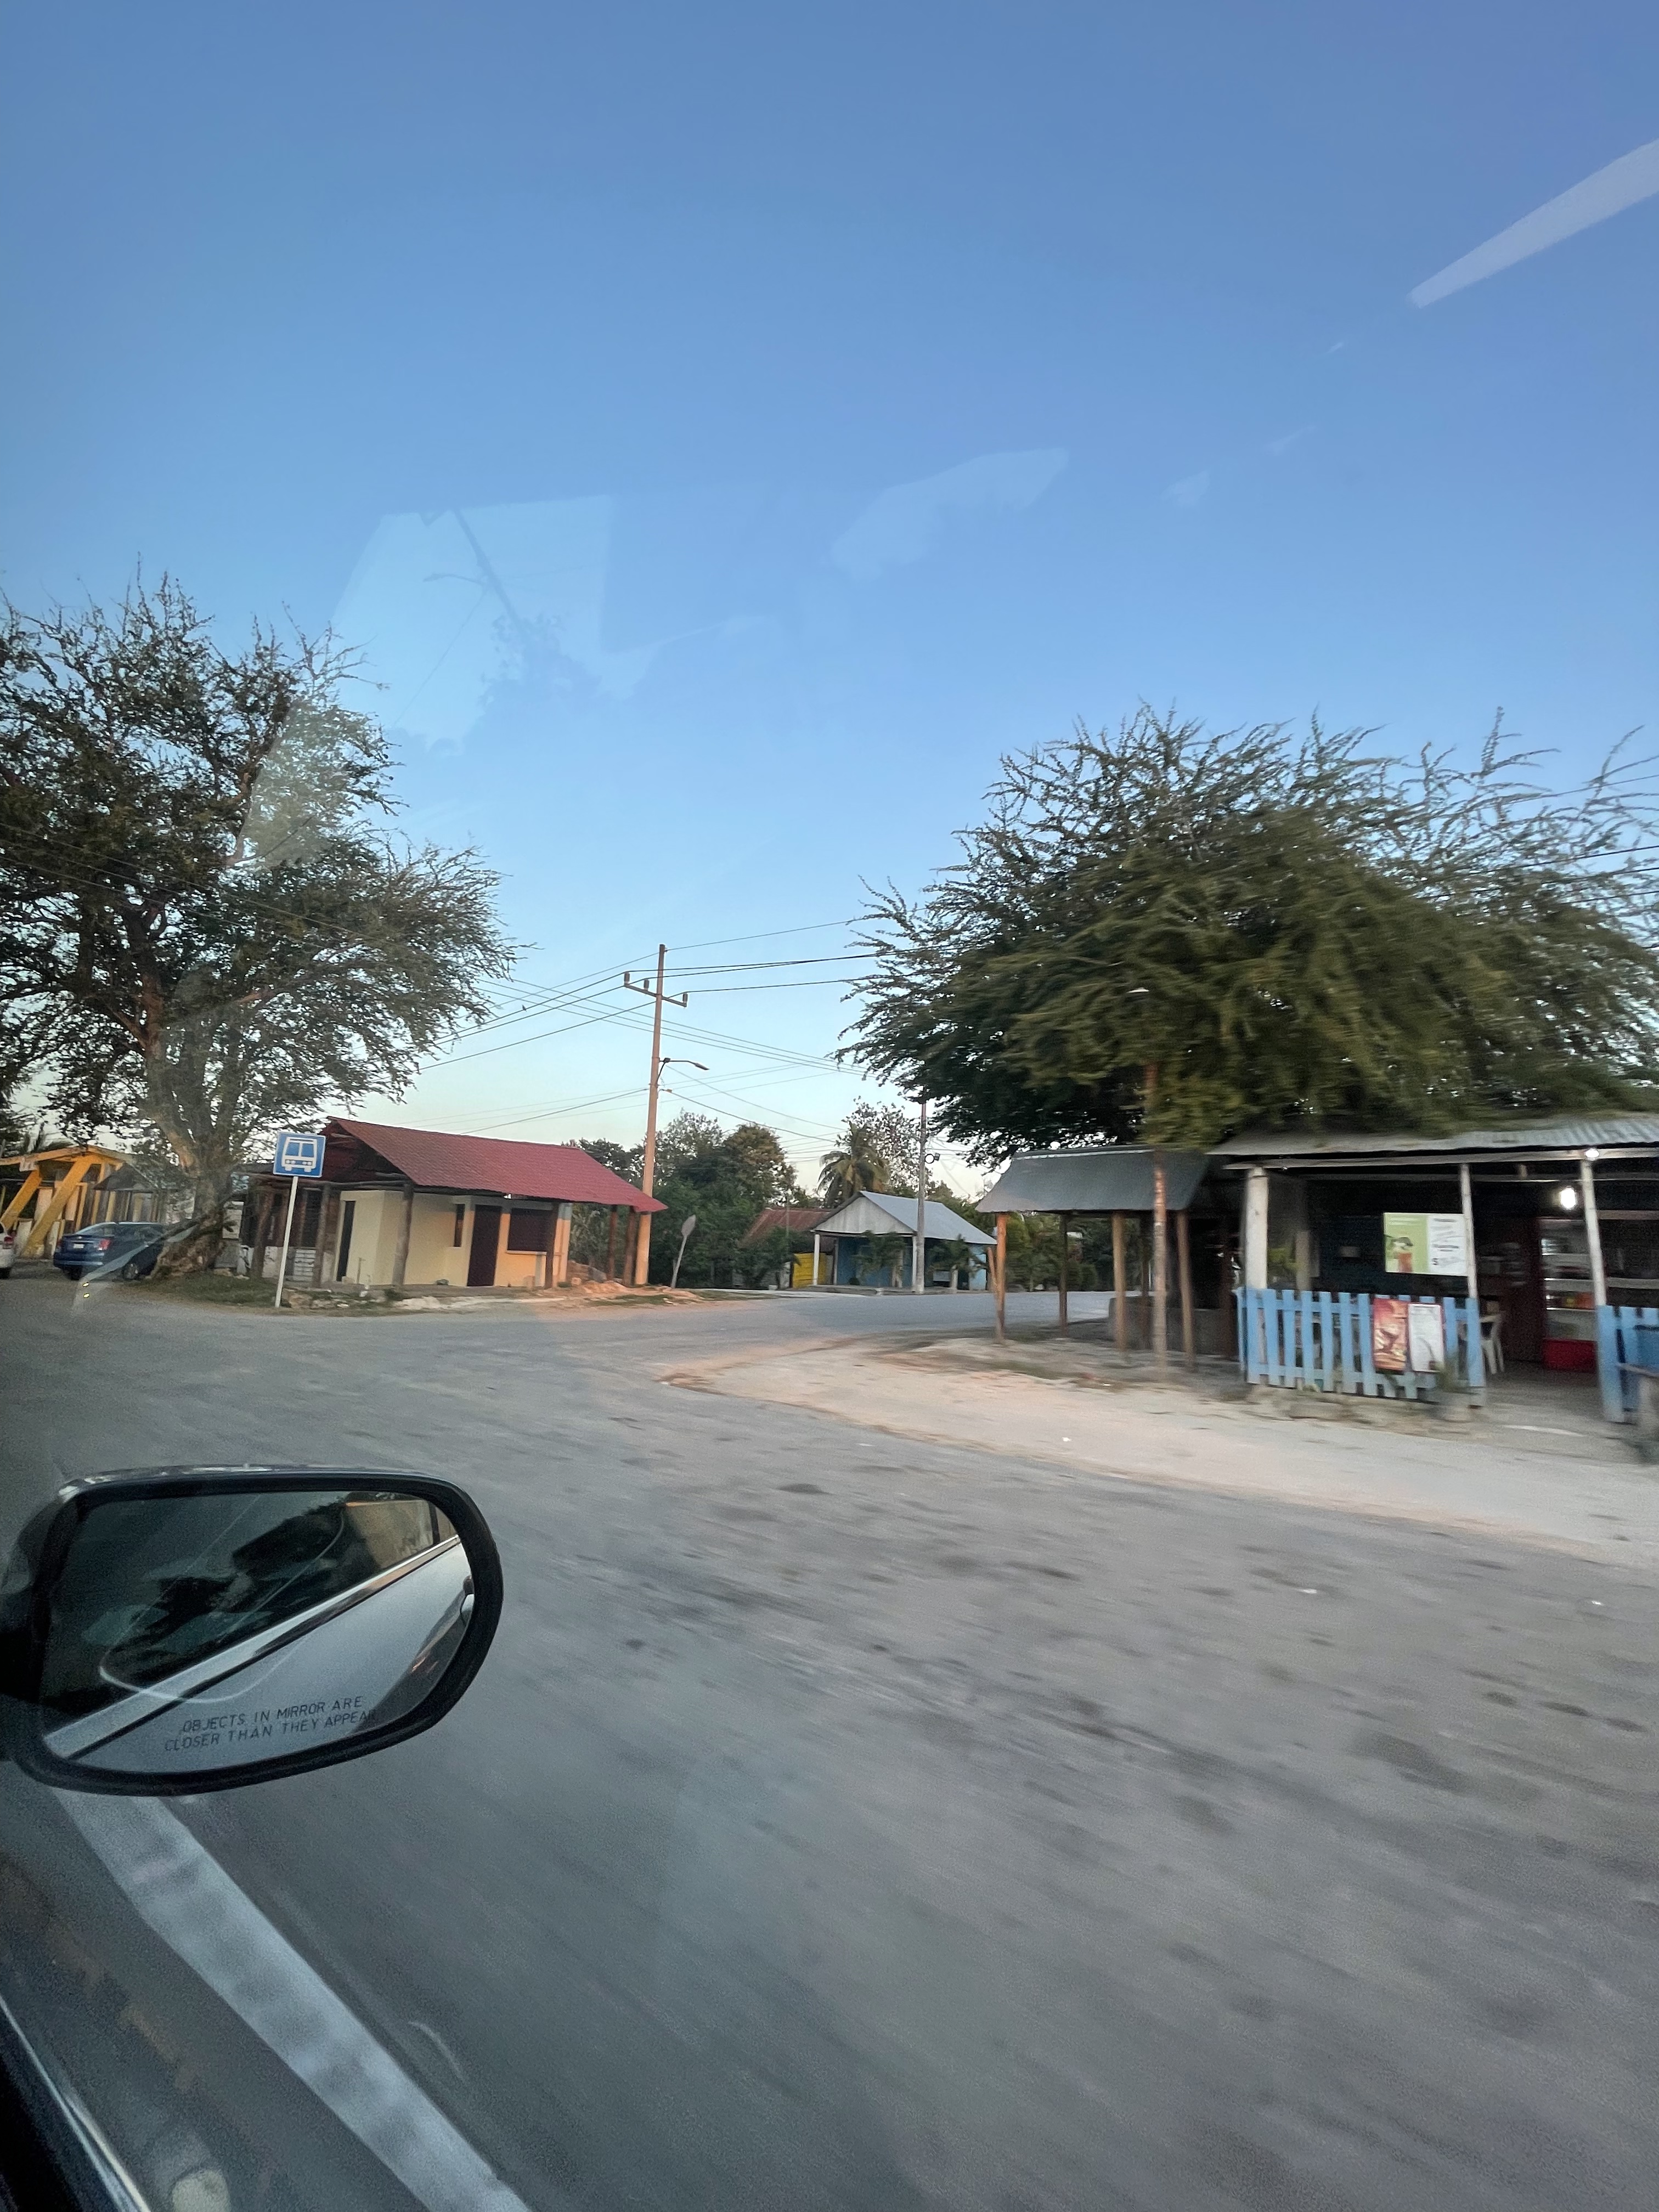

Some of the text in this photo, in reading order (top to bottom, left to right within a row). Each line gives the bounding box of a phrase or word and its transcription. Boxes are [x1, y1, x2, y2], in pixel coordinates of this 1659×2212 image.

[183, 1696, 363, 1732] OBJECTS IN MIRROR ARE
[165, 1734, 219, 1751] CLOSER
[228, 1724, 273, 1742] THAN
[282, 1719, 319, 1734] THEY
